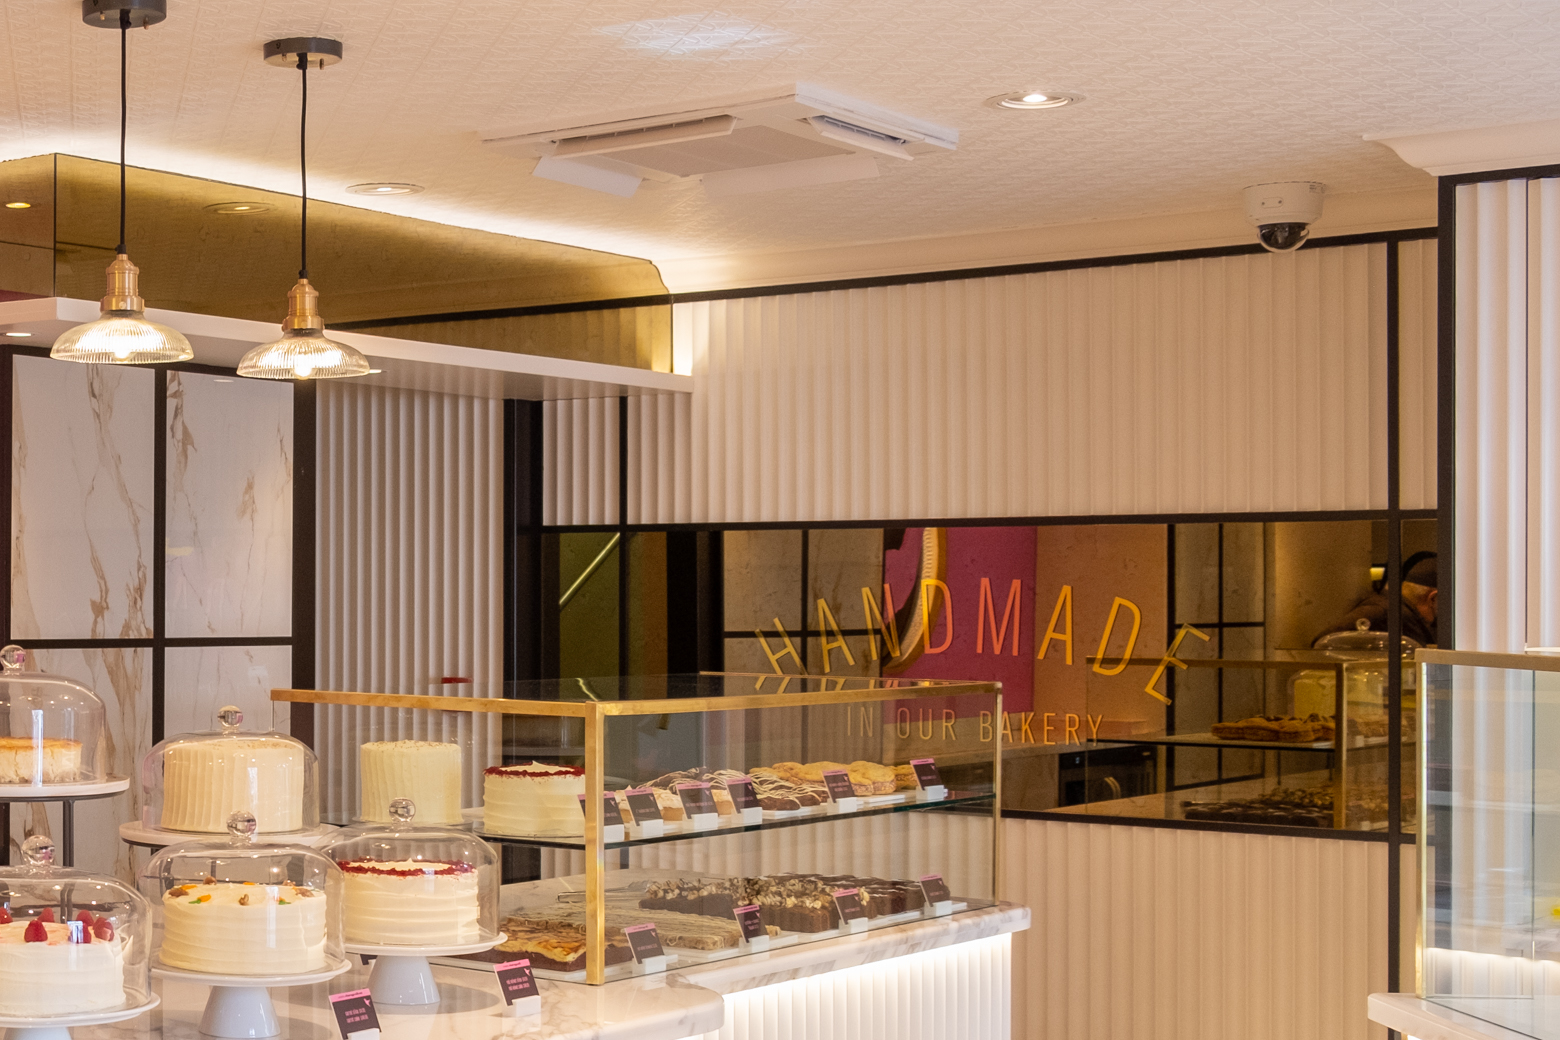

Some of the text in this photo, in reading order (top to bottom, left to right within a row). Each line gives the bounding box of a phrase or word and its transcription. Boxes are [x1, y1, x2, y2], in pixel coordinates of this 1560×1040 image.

[753, 576, 1212, 706] HANDMADE
[846, 705, 1106, 747] IN OUR BAKERY
